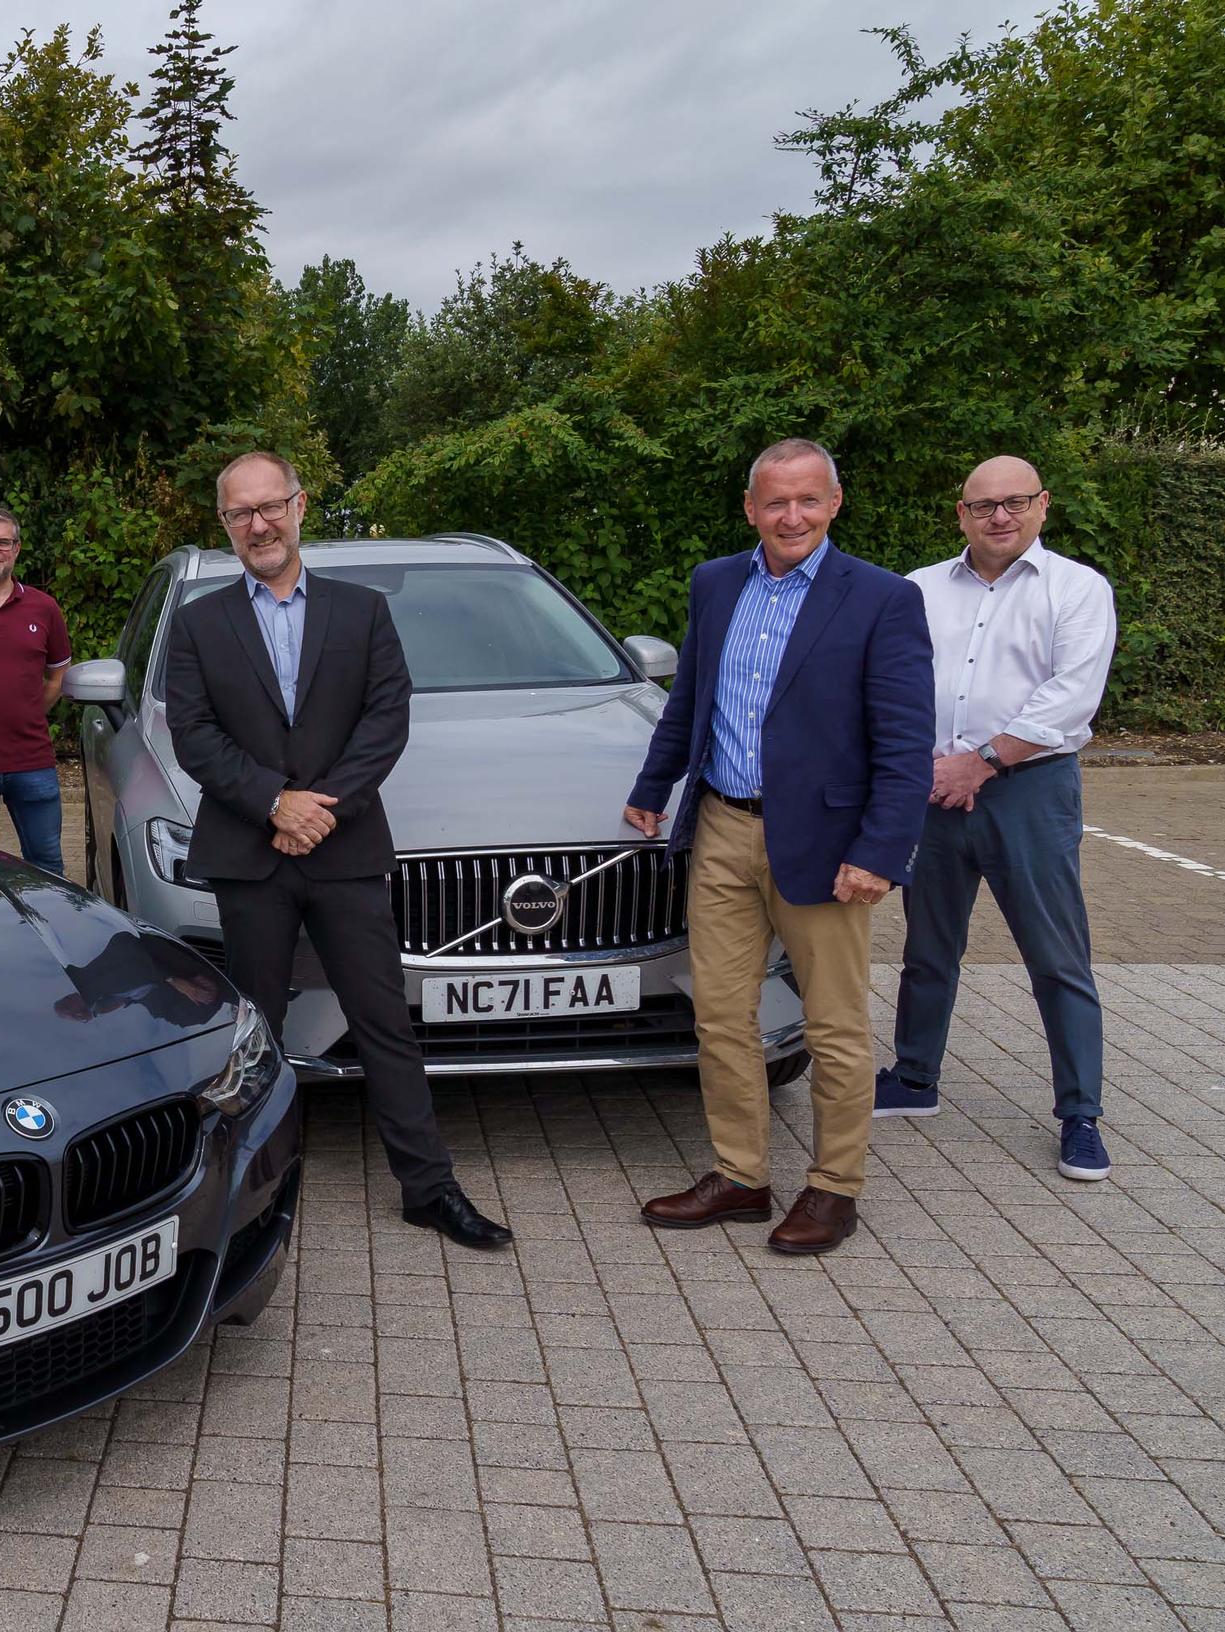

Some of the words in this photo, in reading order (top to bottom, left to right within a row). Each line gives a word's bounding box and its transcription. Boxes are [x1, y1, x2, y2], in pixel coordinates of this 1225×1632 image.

[512, 901, 556, 909] VOLVO
[446, 978, 531, 1015] NC71
[543, 973, 615, 1010] FAA
[7, 1099, 41, 1115] BMW
[87, 1232, 162, 1303] JOB
